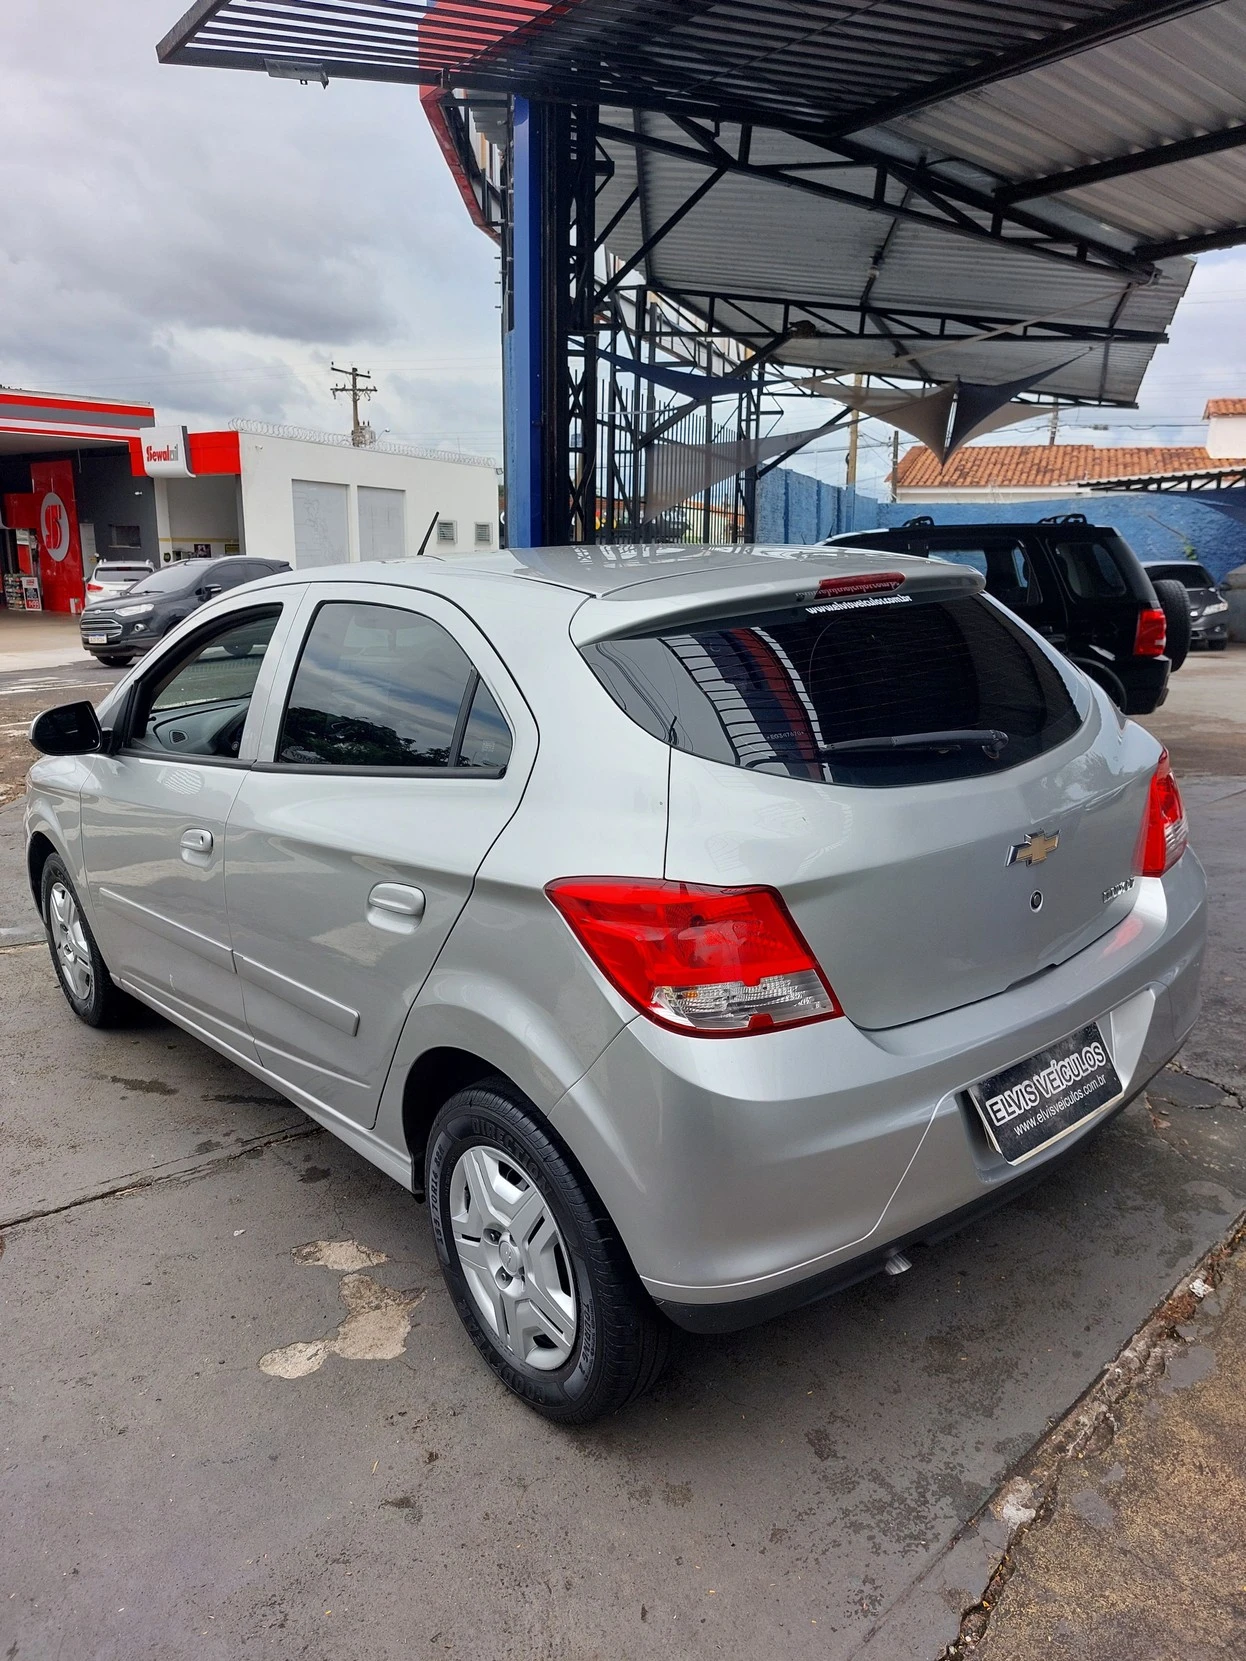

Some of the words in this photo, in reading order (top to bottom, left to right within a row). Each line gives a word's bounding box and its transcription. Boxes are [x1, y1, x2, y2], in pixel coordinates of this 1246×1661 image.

[985, 1080, 1040, 1126] ELVIS
[1034, 1041, 1106, 1100] VEÍCULOS
[1014, 1073, 1107, 1136] www.elvisveiculos.com.br
[471, 1117, 552, 1195] DIRECTION
